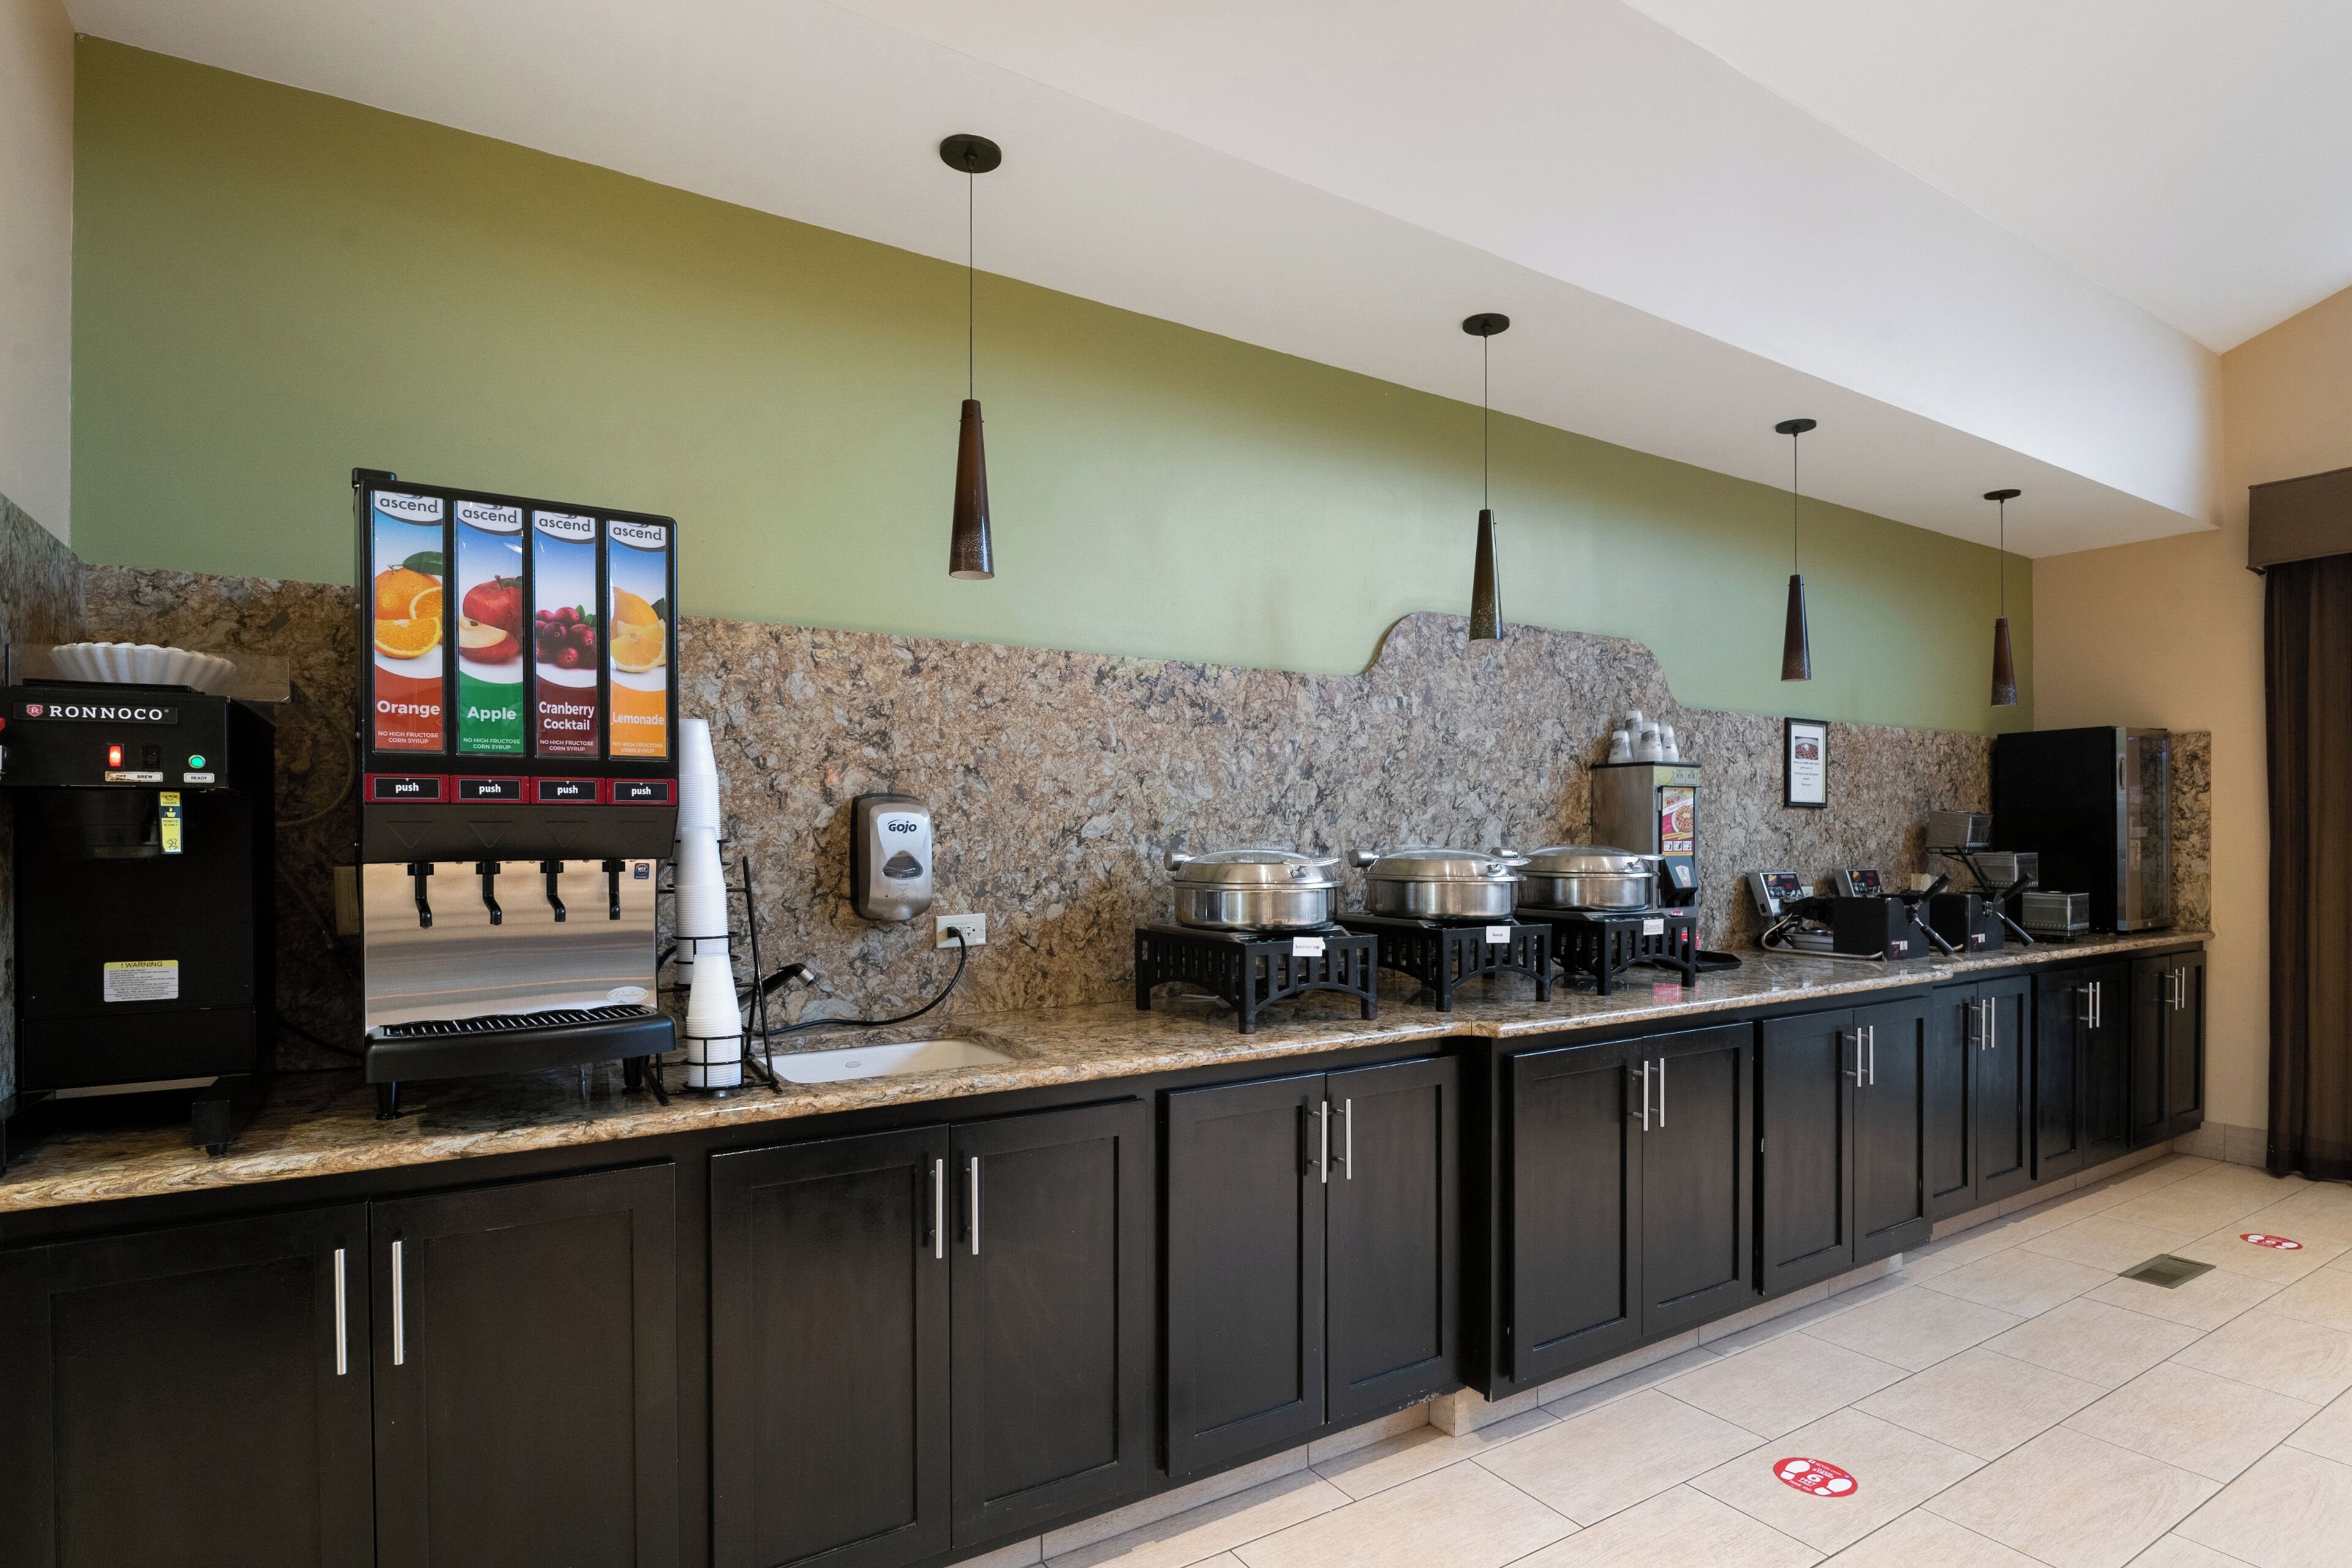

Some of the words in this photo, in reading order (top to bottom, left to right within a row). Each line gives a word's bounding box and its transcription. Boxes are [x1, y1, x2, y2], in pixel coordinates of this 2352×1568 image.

[380, 498, 438, 513] ascend
[462, 509, 517, 524] ascend
[539, 518, 590, 532] ascend
[612, 527, 662, 540] ascend
[50, 706, 163, 720] RONNOCO
[377, 700, 440, 718] Orange
[467, 706, 517, 722] Apple
[538, 701, 595, 718] Cranberry
[543, 718, 590, 731] Cocktail
[612, 712, 665, 725] Lemonade
[395, 783, 420, 794] push
[479, 784, 501, 794] push
[557, 785, 578, 796] push
[631, 786, 651, 796] push
[1807, 1474, 1824, 1482] 6
[1812, 1468, 1834, 1479] STAND
